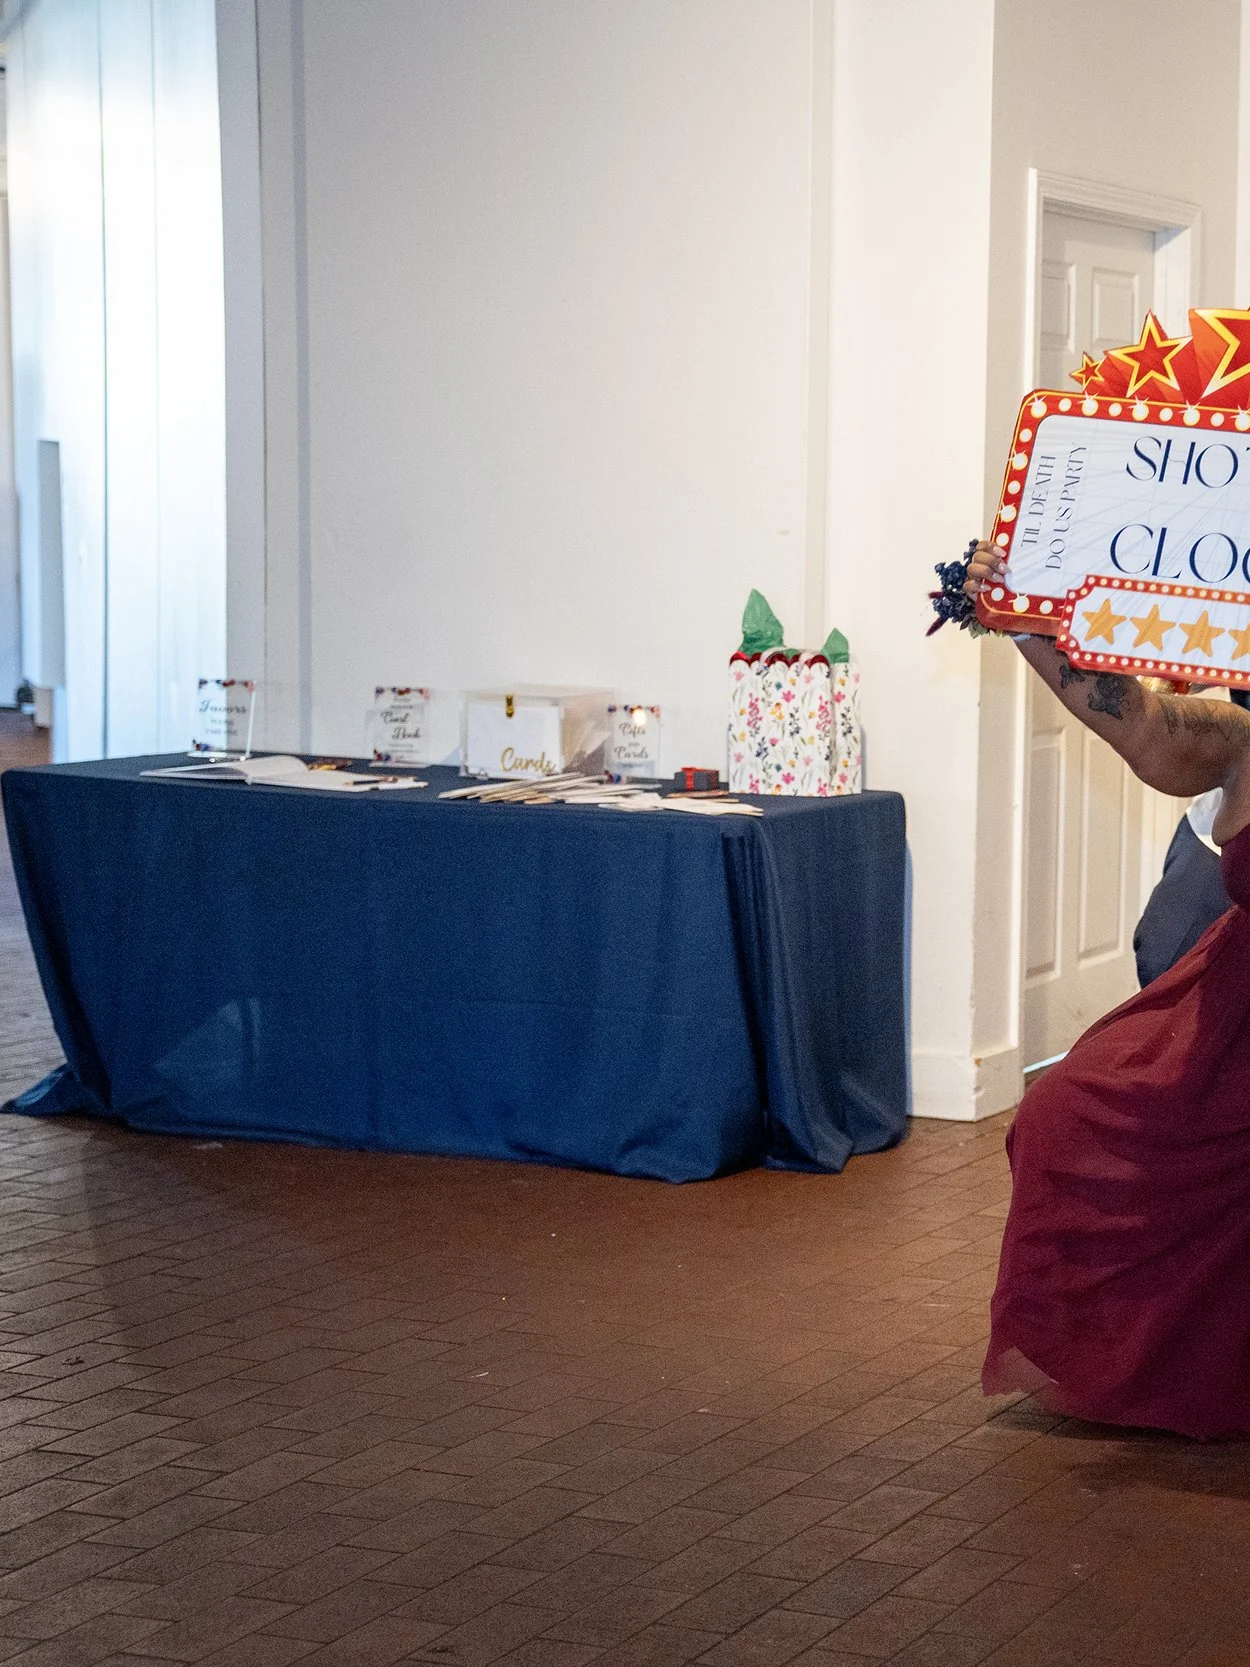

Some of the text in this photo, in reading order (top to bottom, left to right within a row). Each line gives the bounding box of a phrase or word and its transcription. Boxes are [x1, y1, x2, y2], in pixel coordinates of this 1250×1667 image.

[1020, 455, 1056, 547] TIL DEATH
[1045, 442, 1087, 569] DO US PARTY
[501, 747, 557, 774] Cards
